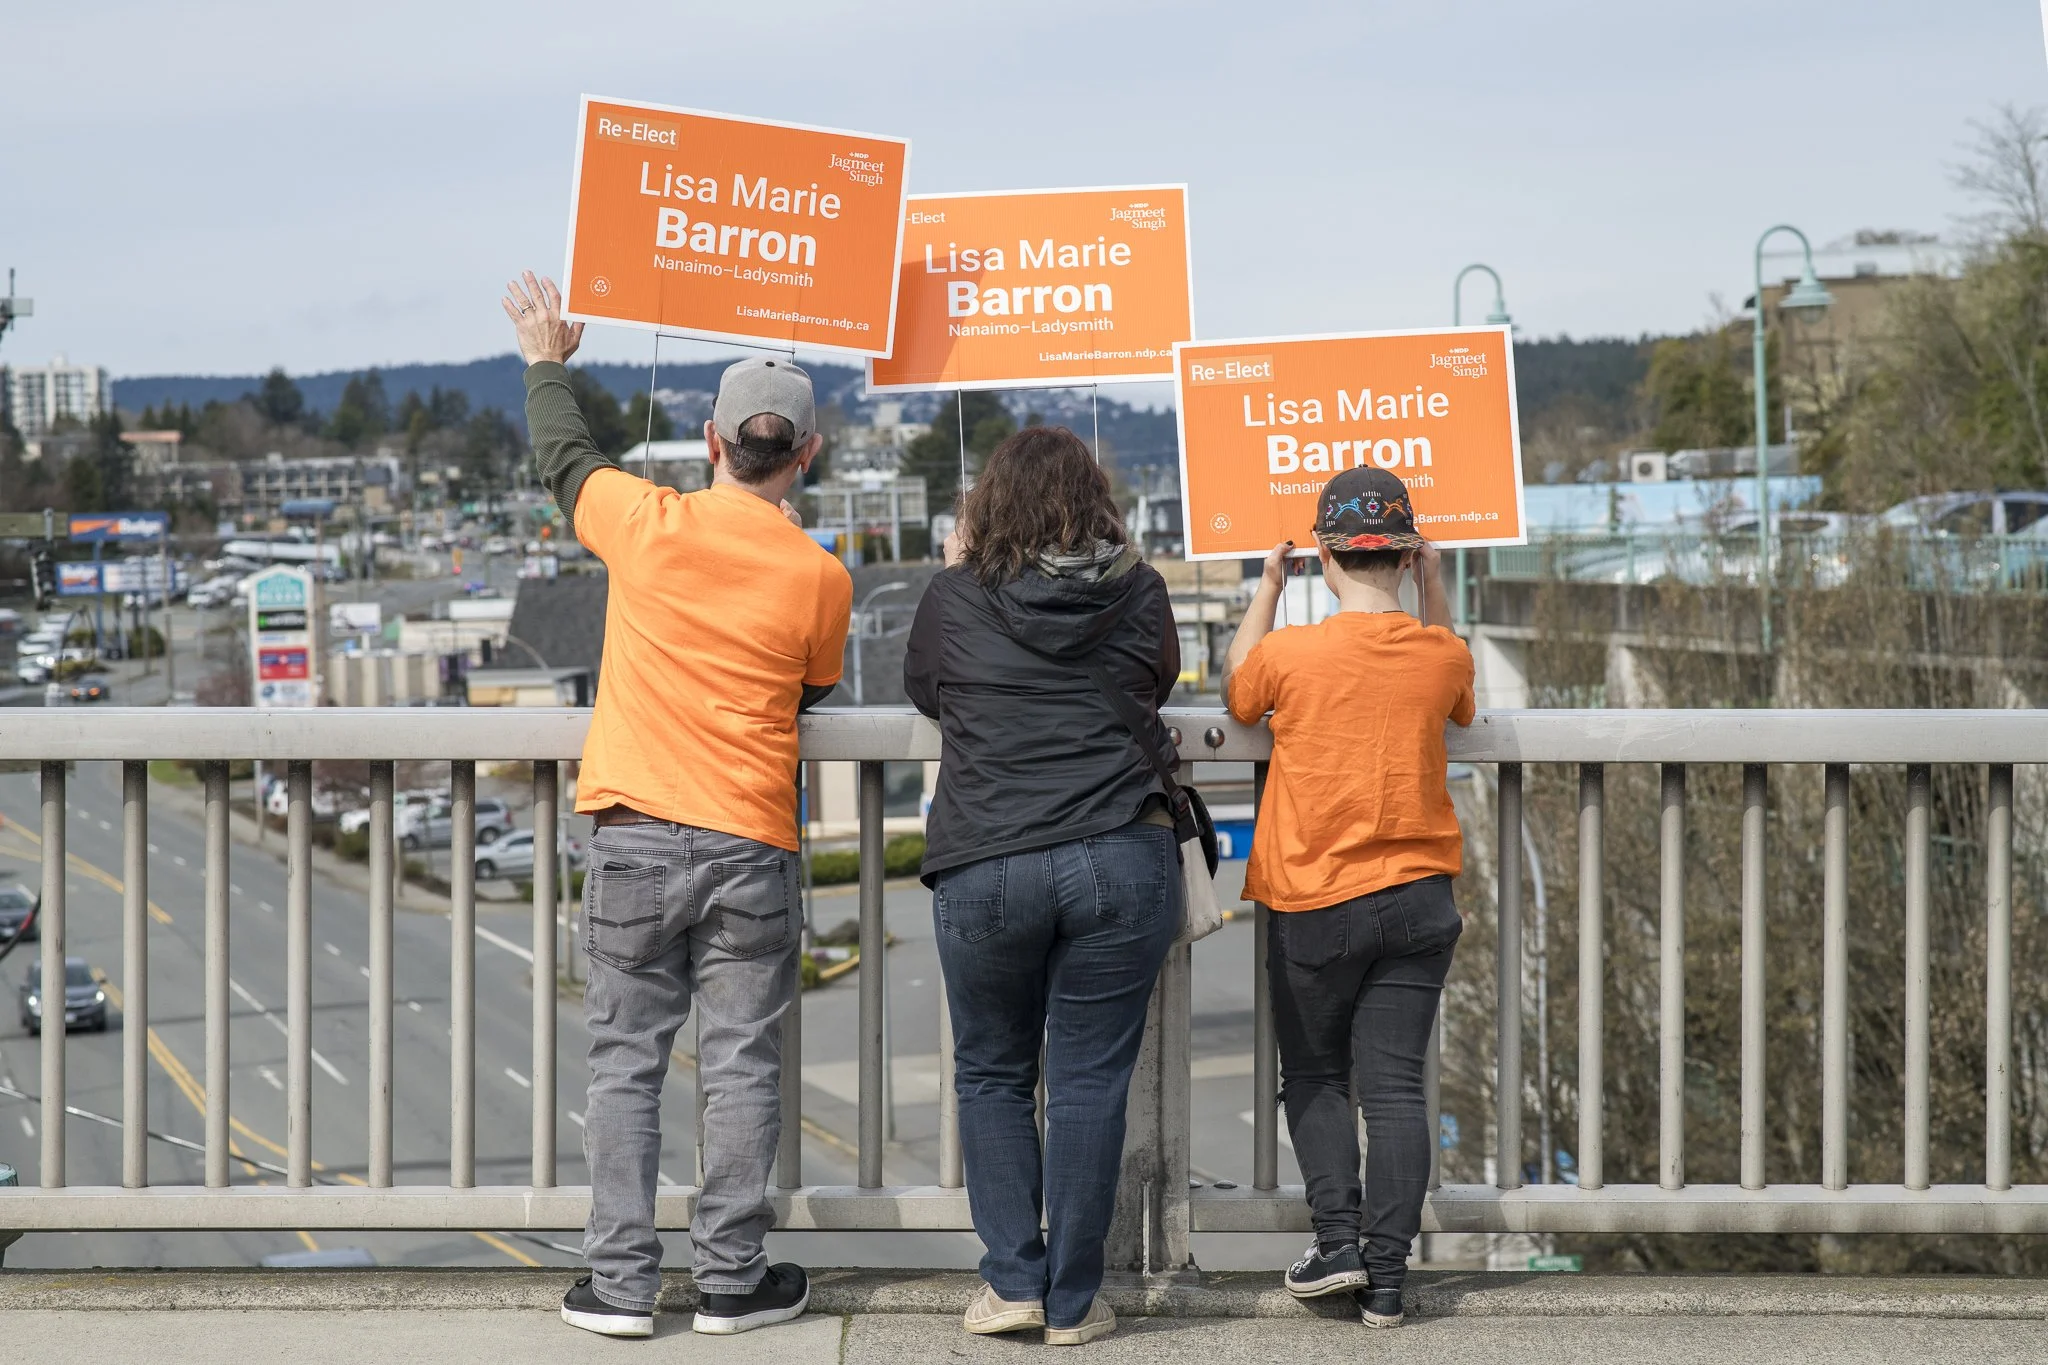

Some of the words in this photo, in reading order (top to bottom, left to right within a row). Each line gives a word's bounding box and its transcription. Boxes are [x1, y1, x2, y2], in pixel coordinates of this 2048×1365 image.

[598, 118, 678, 146] Re-Elect
[828, 153, 885, 173] Jagmeet
[849, 169, 884, 187] Singh
[639, 161, 718, 204] Lisa
[731, 173, 842, 220] Marie
[906, 211, 946, 225] -Elect
[1109, 207, 1166, 221] Jagmeet
[1131, 217, 1167, 231] Singh
[655, 206, 818, 267] Barron
[925, 242, 1005, 274] Lisa
[1019, 235, 1132, 270] Marie
[947, 281, 1113, 318] Barron
[736, 305, 870, 332] LisaMarieBarron.ndp.ca
[1039, 347, 1173, 362] LisaMarieBarron.ndp.ca
[1429, 352, 1487, 368] Jagmeet
[1191, 360, 1271, 382] Re-Elect
[1452, 364, 1488, 379] Singh
[1243, 392, 1324, 427] Lisa
[1337, 385, 1449, 422] Marie
[1267, 435, 1433, 474] Barron
[1413, 511, 1499, 524] eBarron.ndp.ca
